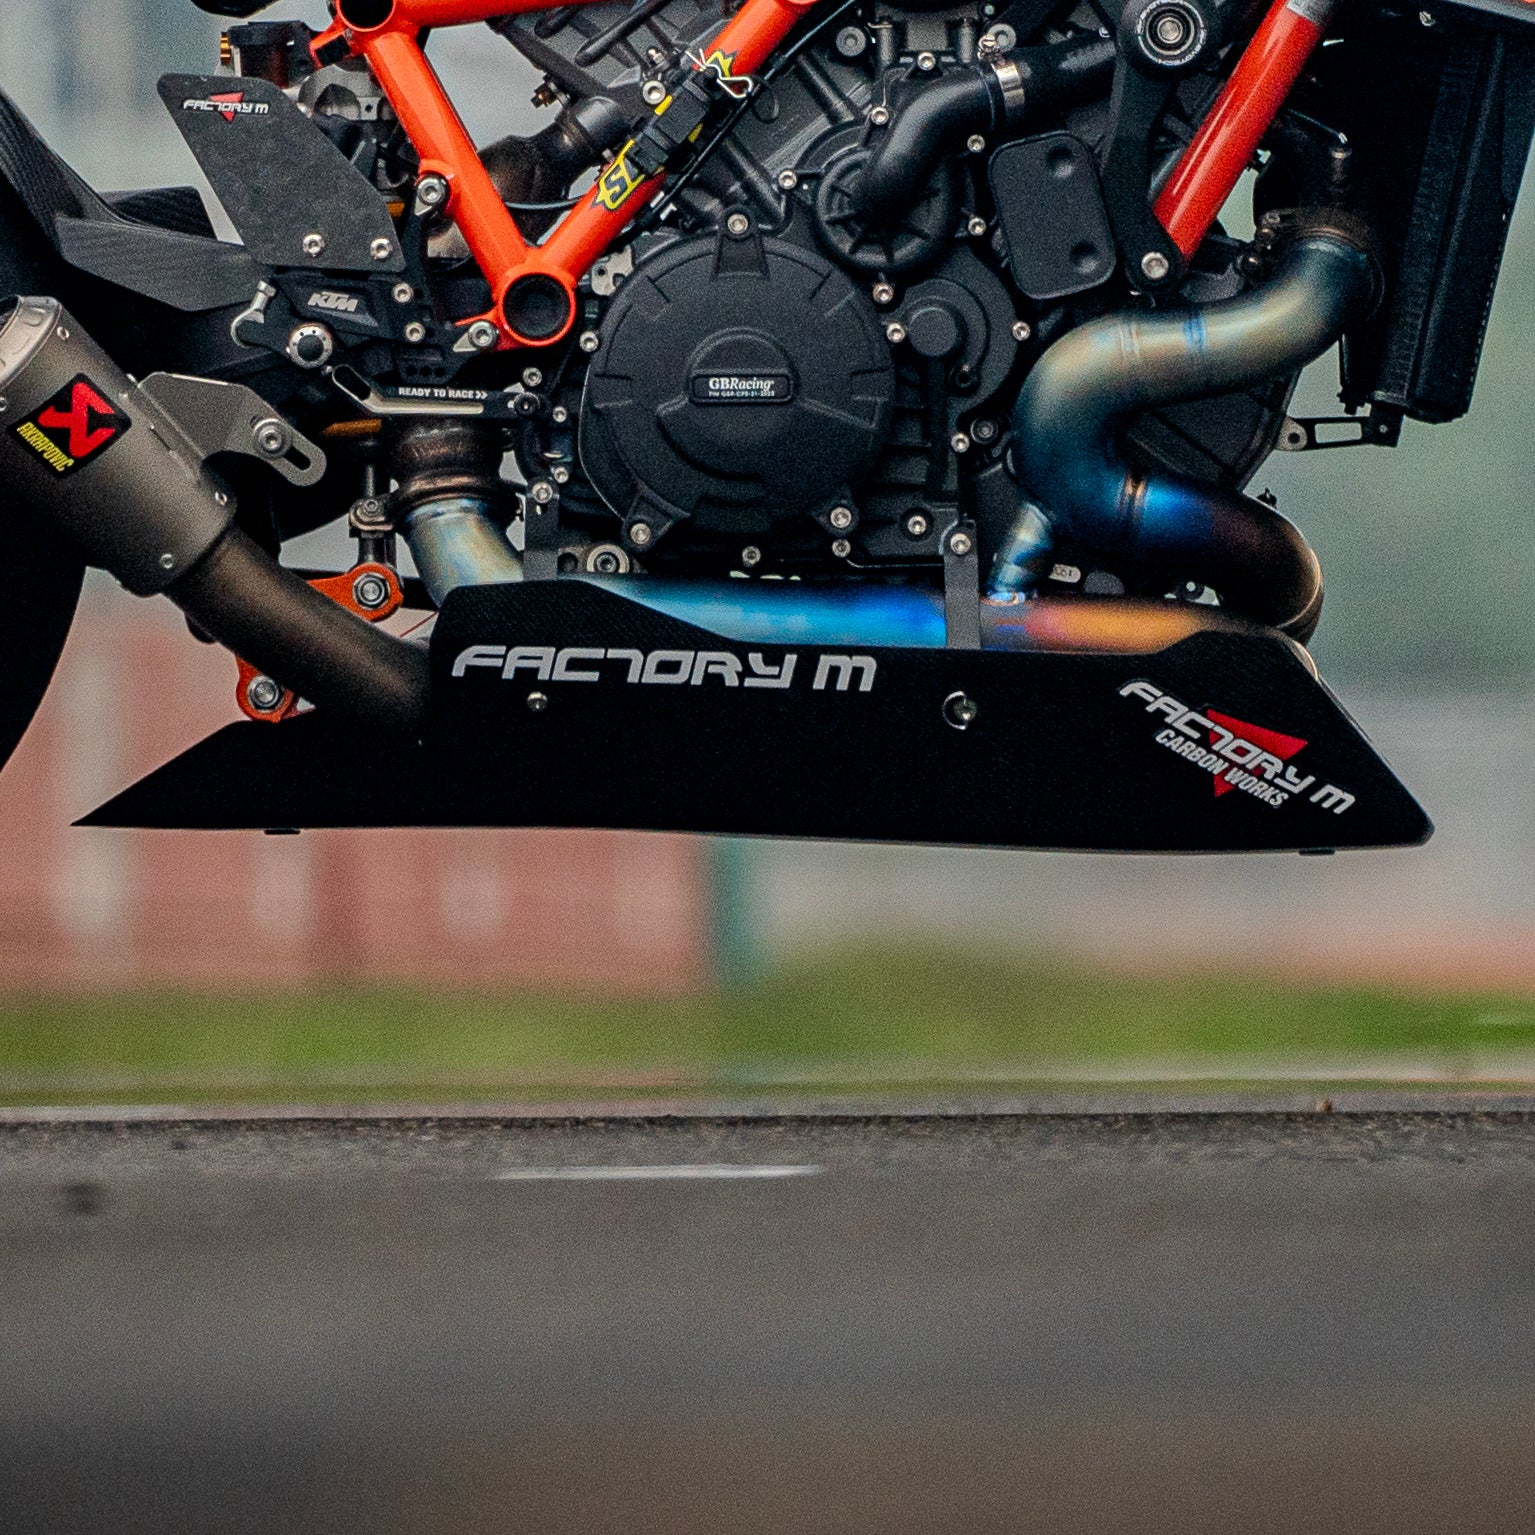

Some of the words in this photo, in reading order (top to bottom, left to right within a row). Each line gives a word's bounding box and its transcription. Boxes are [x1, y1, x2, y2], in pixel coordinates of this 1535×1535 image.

[183, 98, 252, 113] FACTORY
[307, 291, 358, 312] KTM
[398, 387, 431, 397] READY
[433, 388, 446, 398] TO
[448, 389, 474, 399] RACE
[709, 376, 771, 392] GBRacing
[452, 645, 797, 690] FACTORY
[812, 654, 877, 692] M
[1119, 681, 1315, 795] FACTORY
[1310, 783, 1356, 815] M
[1155, 728, 1228, 776] CARBON
[1224, 768, 1289, 808] WORKS
